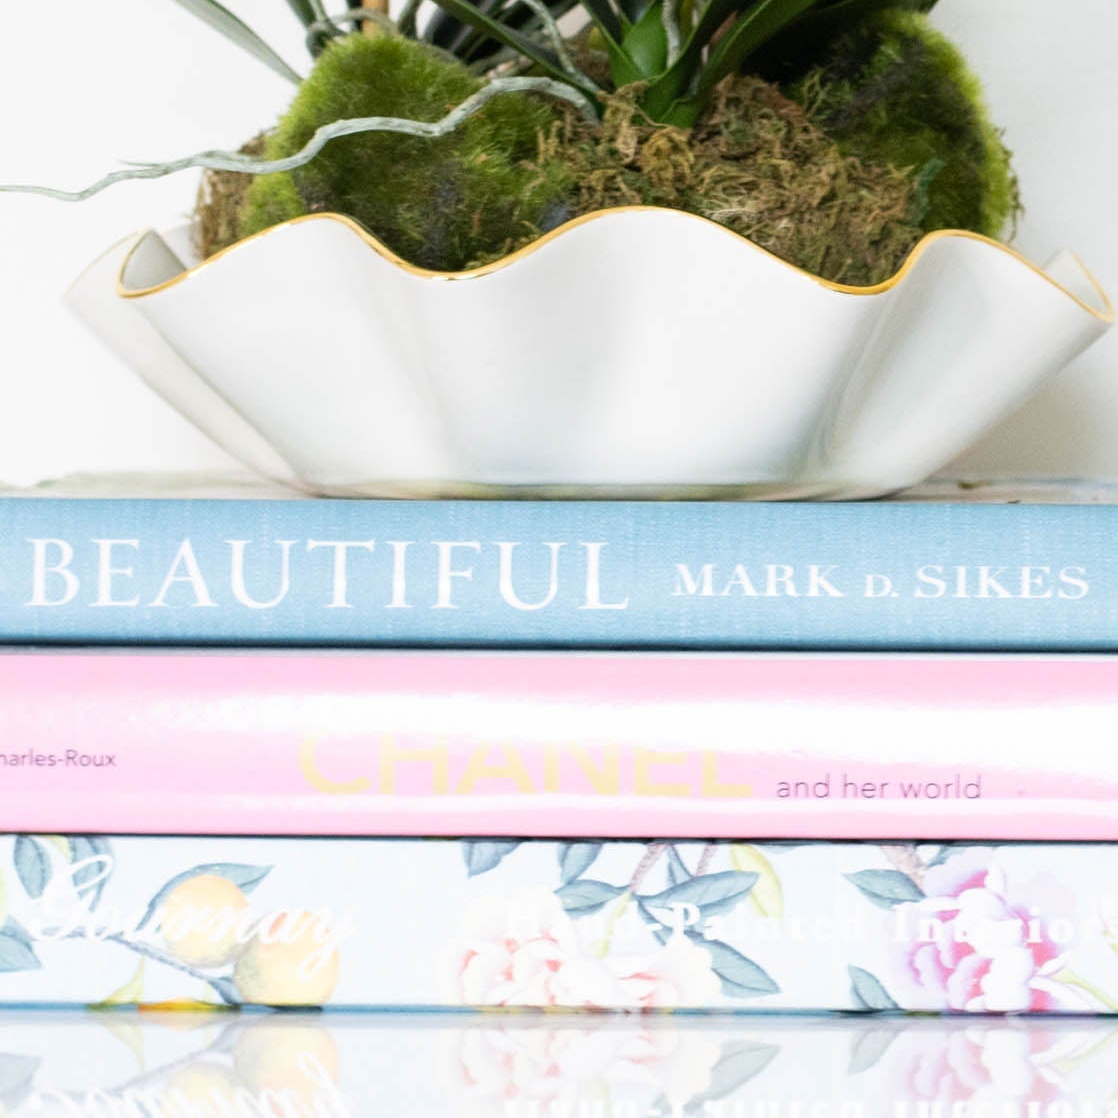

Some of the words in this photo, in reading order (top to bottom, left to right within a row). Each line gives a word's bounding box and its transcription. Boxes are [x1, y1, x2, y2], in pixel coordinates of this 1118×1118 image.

[24, 537, 631, 612] BEAUTIFUL
[671, 563, 846, 598] MARK
[863, 573, 900, 599] D.
[914, 564, 1090, 600] SIKES
[296, 720, 755, 799] CHANEL
[776, 772, 831, 800] and
[842, 772, 889, 800] her
[899, 772, 982, 800] world
